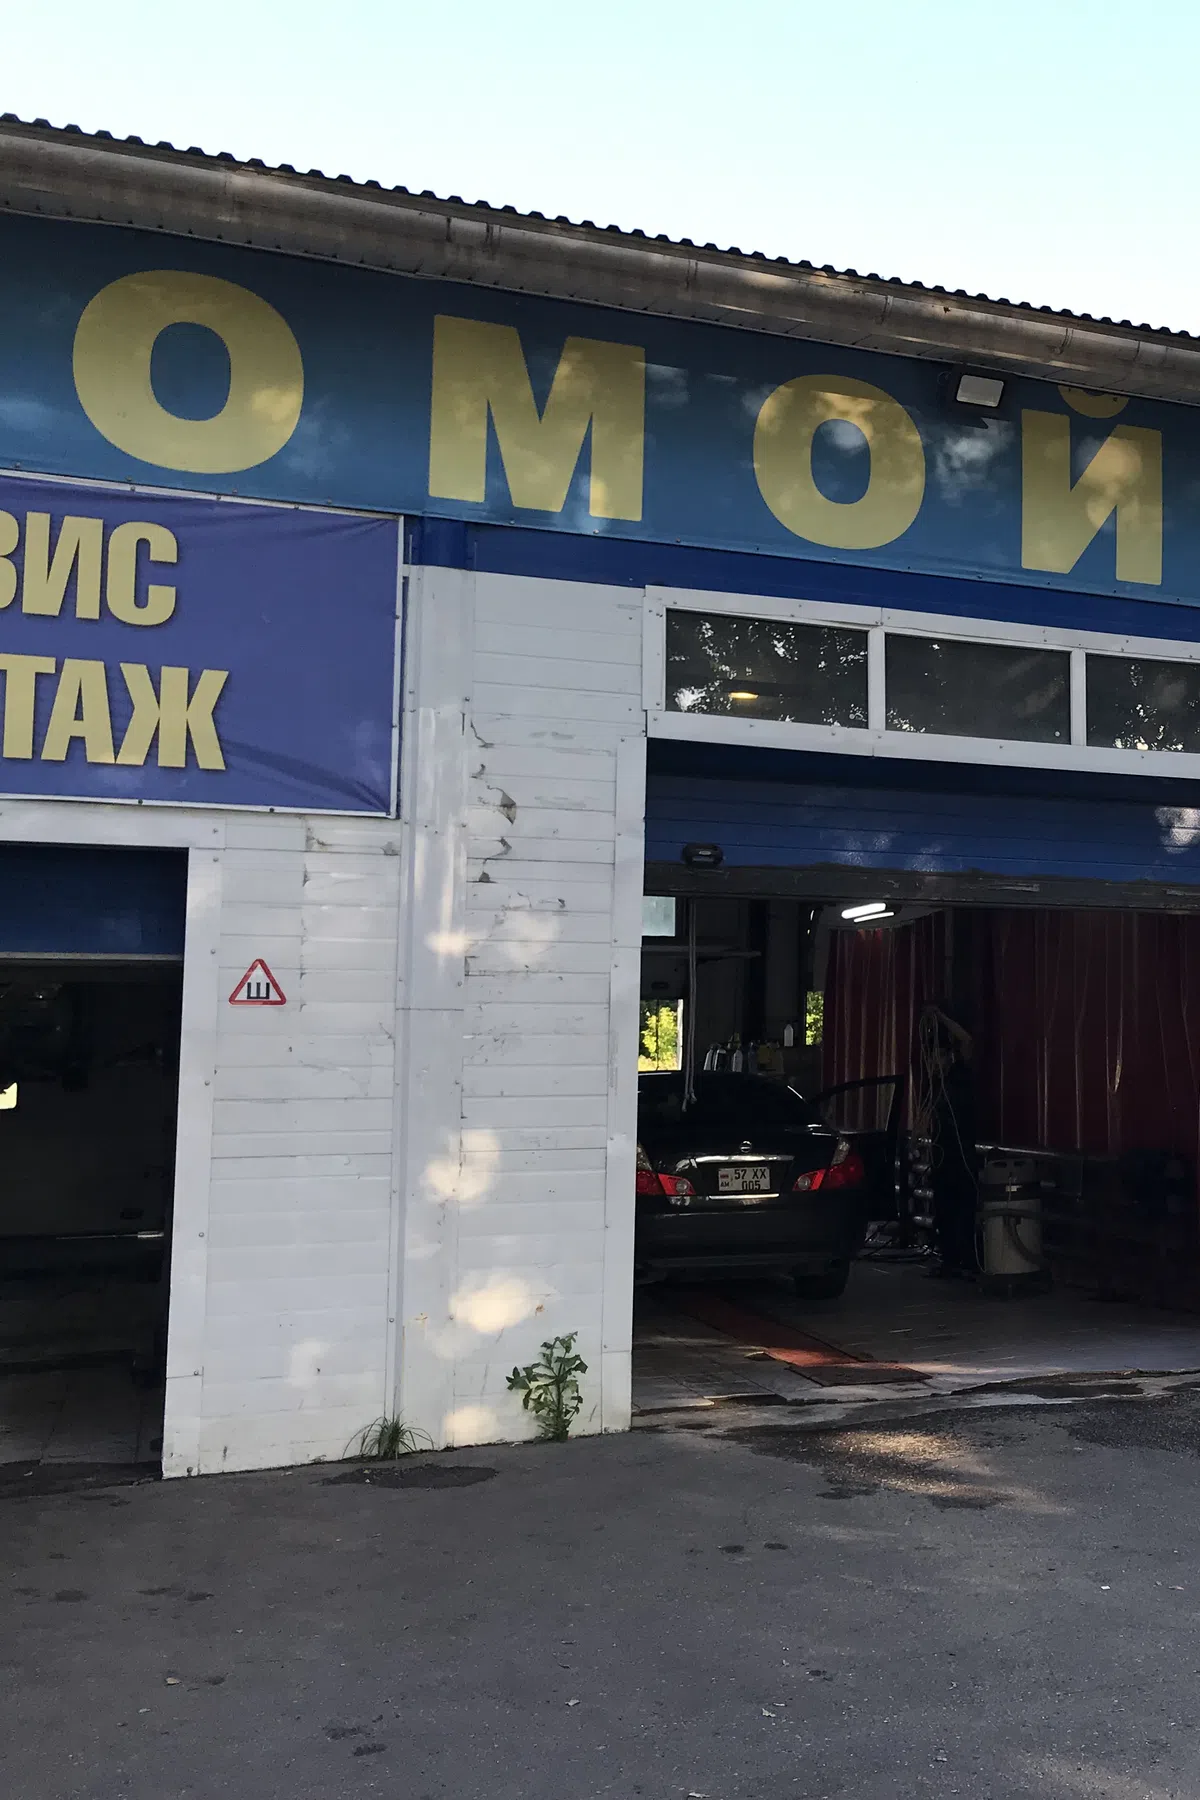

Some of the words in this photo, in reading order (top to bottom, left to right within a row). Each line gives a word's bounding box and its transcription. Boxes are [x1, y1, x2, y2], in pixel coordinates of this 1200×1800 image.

[0, 508, 178, 626] ИС
[0, 653, 229, 771] ТАЖ
[246, 982, 271, 1000] Ш
[734, 1169, 747, 1180] 57
[741, 1180, 761, 1191] 005
